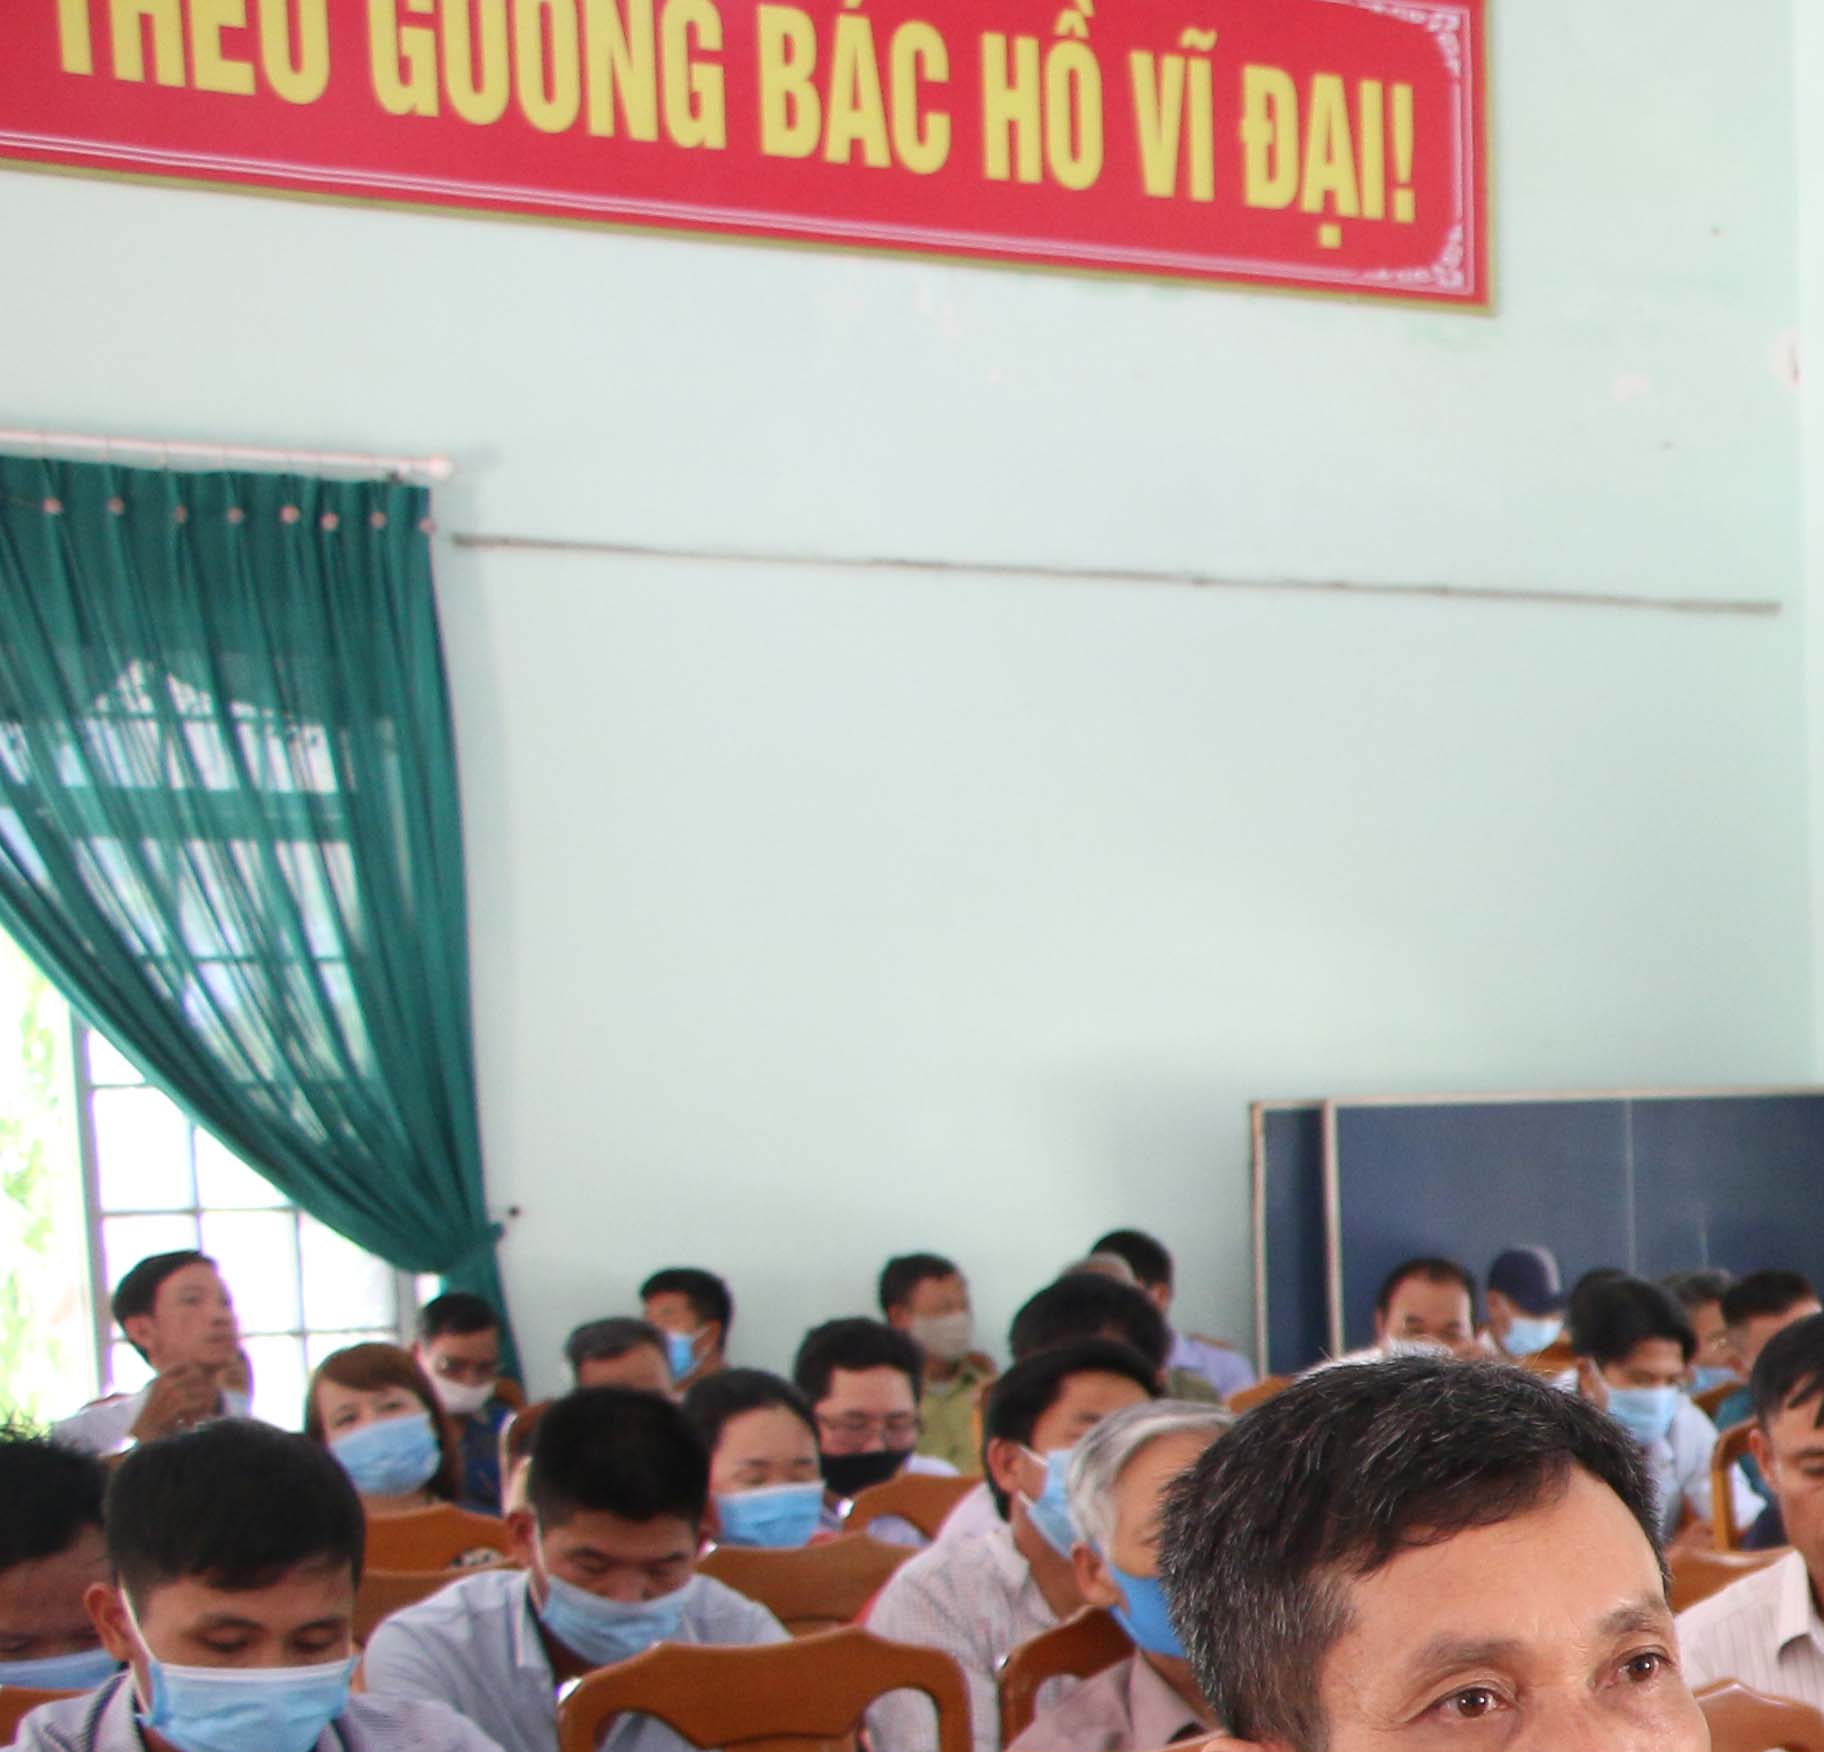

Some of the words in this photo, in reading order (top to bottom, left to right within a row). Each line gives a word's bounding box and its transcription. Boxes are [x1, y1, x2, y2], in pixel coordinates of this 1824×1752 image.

[759, 0, 949, 173] BÁC
[983, 0, 1101, 189] HỒ
[1131, 29, 1214, 200] VĨ
[1242, 66, 1413, 246] ĐẠI!
